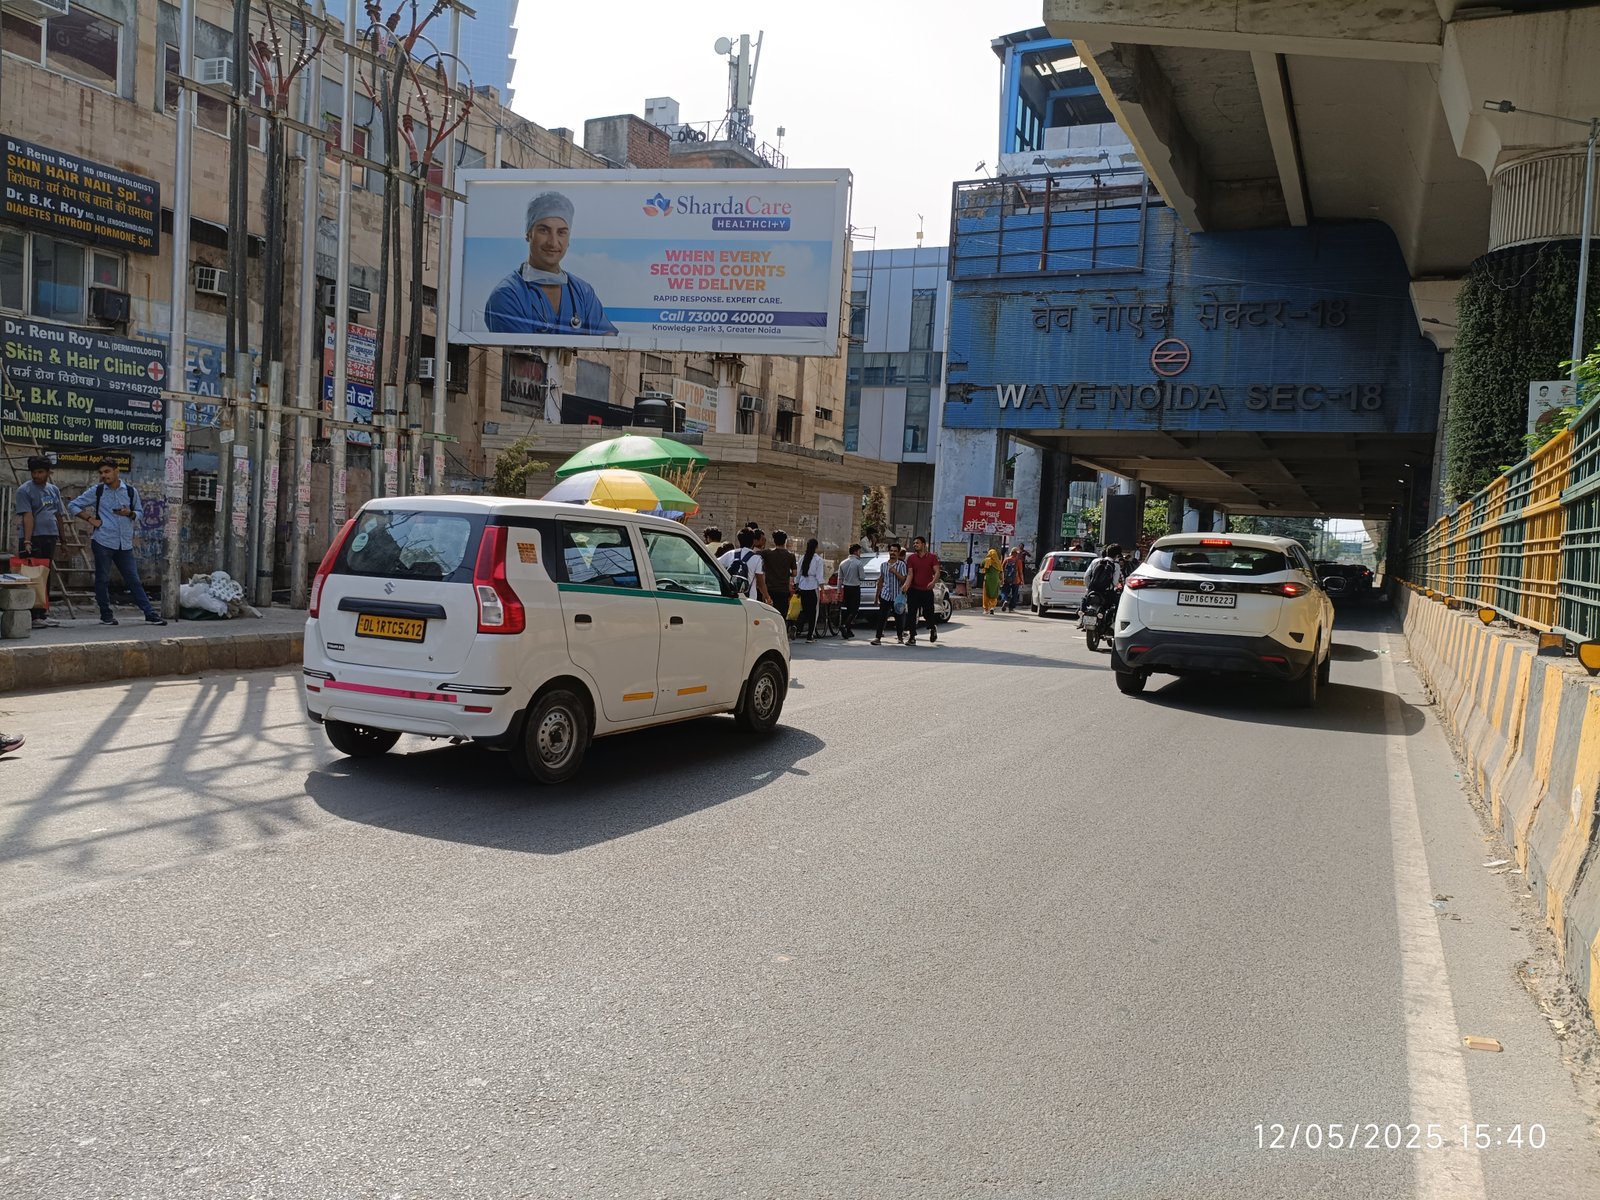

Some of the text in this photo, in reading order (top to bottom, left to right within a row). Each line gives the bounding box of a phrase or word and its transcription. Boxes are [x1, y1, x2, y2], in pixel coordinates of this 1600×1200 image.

[8, 141, 154, 194] Dr. Renu Roy MD (DERMATOLOGIST)
[8, 154, 140, 202] SKIN HAIR NAIL Spl.
[62, 184, 76, 200] रोग
[6, 188, 24, 201] Dr.
[30, 193, 55, 210] B.K.
[60, 202, 84, 218] Roy
[676, 195, 792, 215] ShardaCare
[6, 202, 152, 248] DIABETES THYROID HORMONE Spl.
[665, 250, 771, 263] WHEN EVERY
[650, 264, 786, 277] SECOND COUNTS
[668, 278, 766, 291] WE DELIVER
[726, 296, 756, 304] EXPERT
[660, 311, 774, 324] Call 73000 40000
[1032, 296, 1077, 332] वेव
[652, 324, 696, 333] Knowledge
[5, 321, 163, 359] Dr. Renu Roy M.D. (DERMATOLOGIST)
[5, 342, 145, 377] Skin & Hair Clinic
[35, 368, 55, 380] रोग
[4, 384, 94, 414] Dr. B.K. Roy
[996, 382, 1384, 410] WAVE NOIDA SEC-18
[3, 409, 19, 422] Spl.
[24, 411, 59, 425] DIABETES
[95, 419, 124, 430] THYROID
[3, 425, 162, 447] HORMONE Disorder 9810145142
[1185, 595, 1234, 605] UP16CY6223
[363, 619, 422, 637] DL1RTC5412
